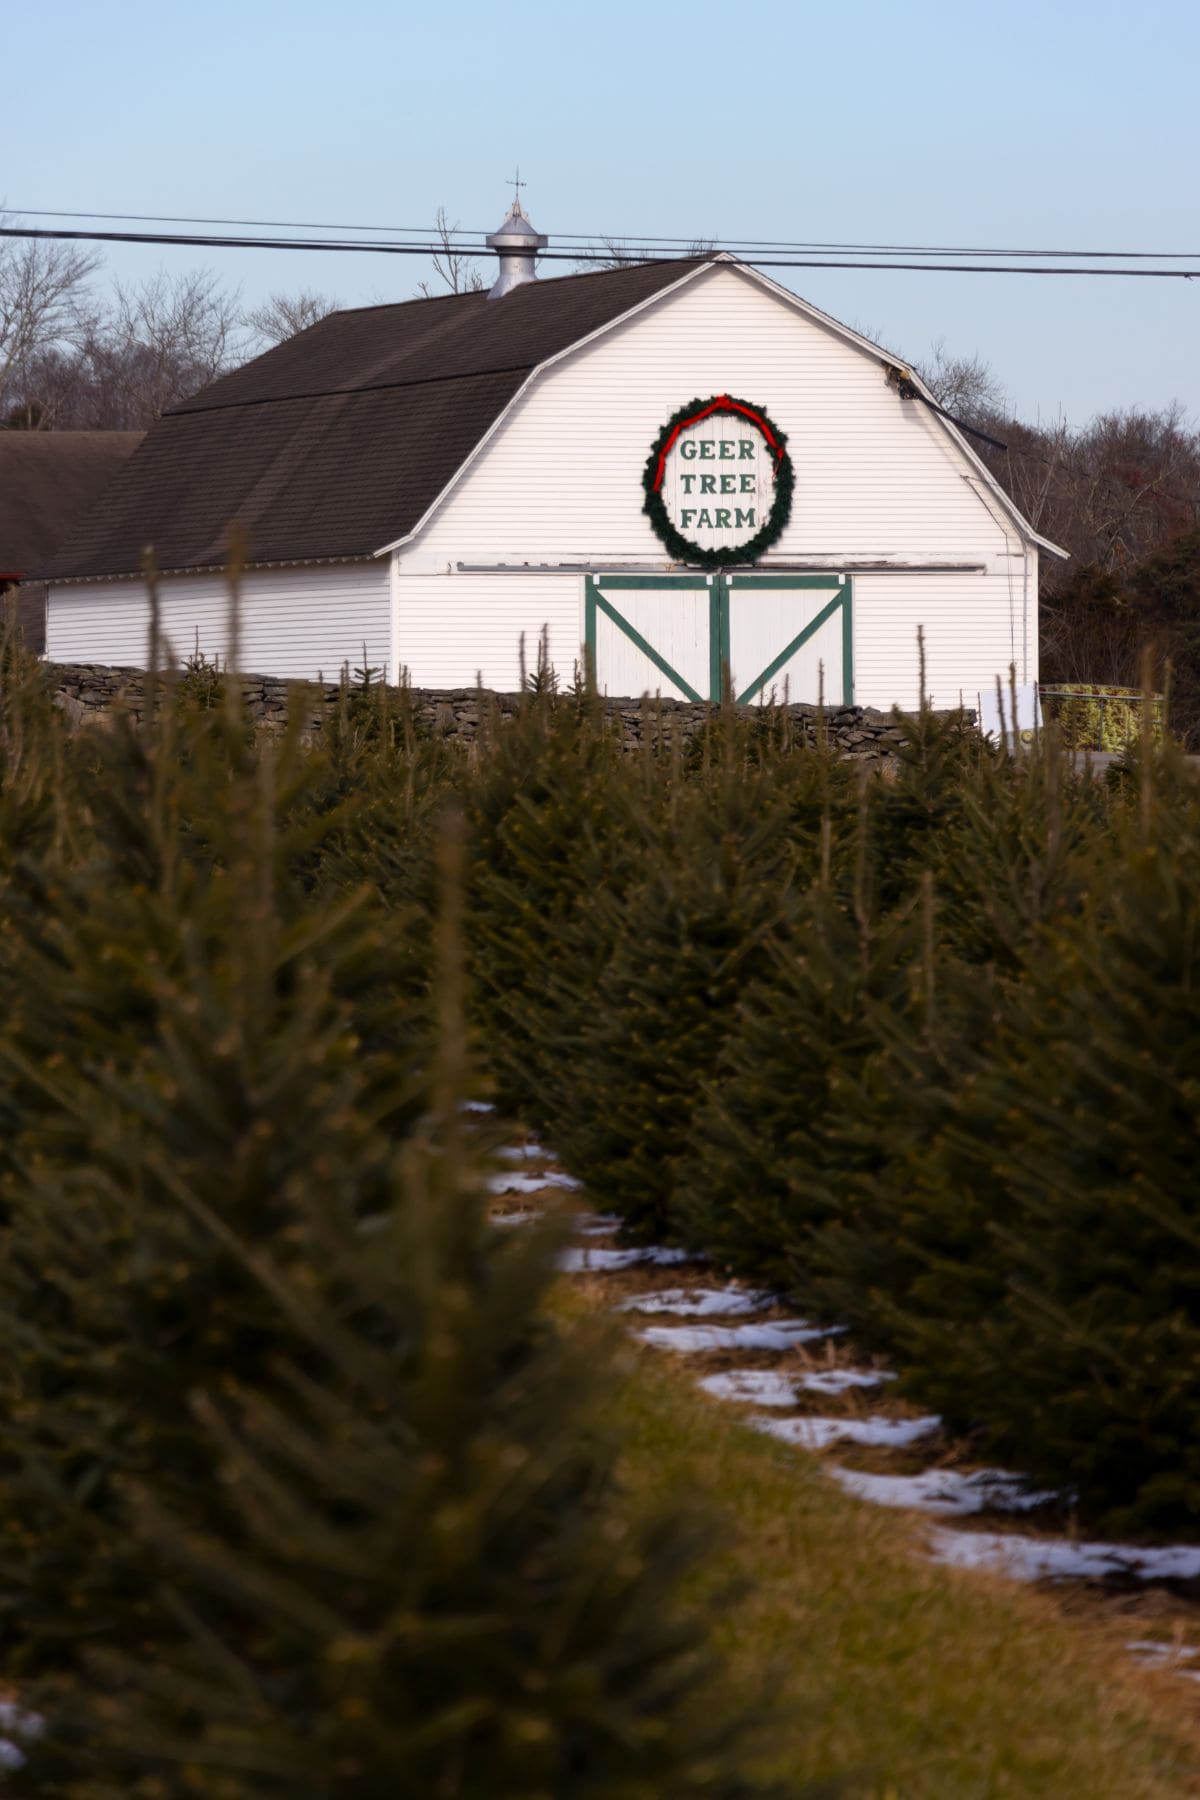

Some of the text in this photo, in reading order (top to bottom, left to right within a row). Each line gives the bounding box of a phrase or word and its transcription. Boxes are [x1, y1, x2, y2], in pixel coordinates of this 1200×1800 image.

[680, 439, 755, 460] GEER
[680, 474, 756, 494] TREE
[680, 508, 756, 529] FARM
